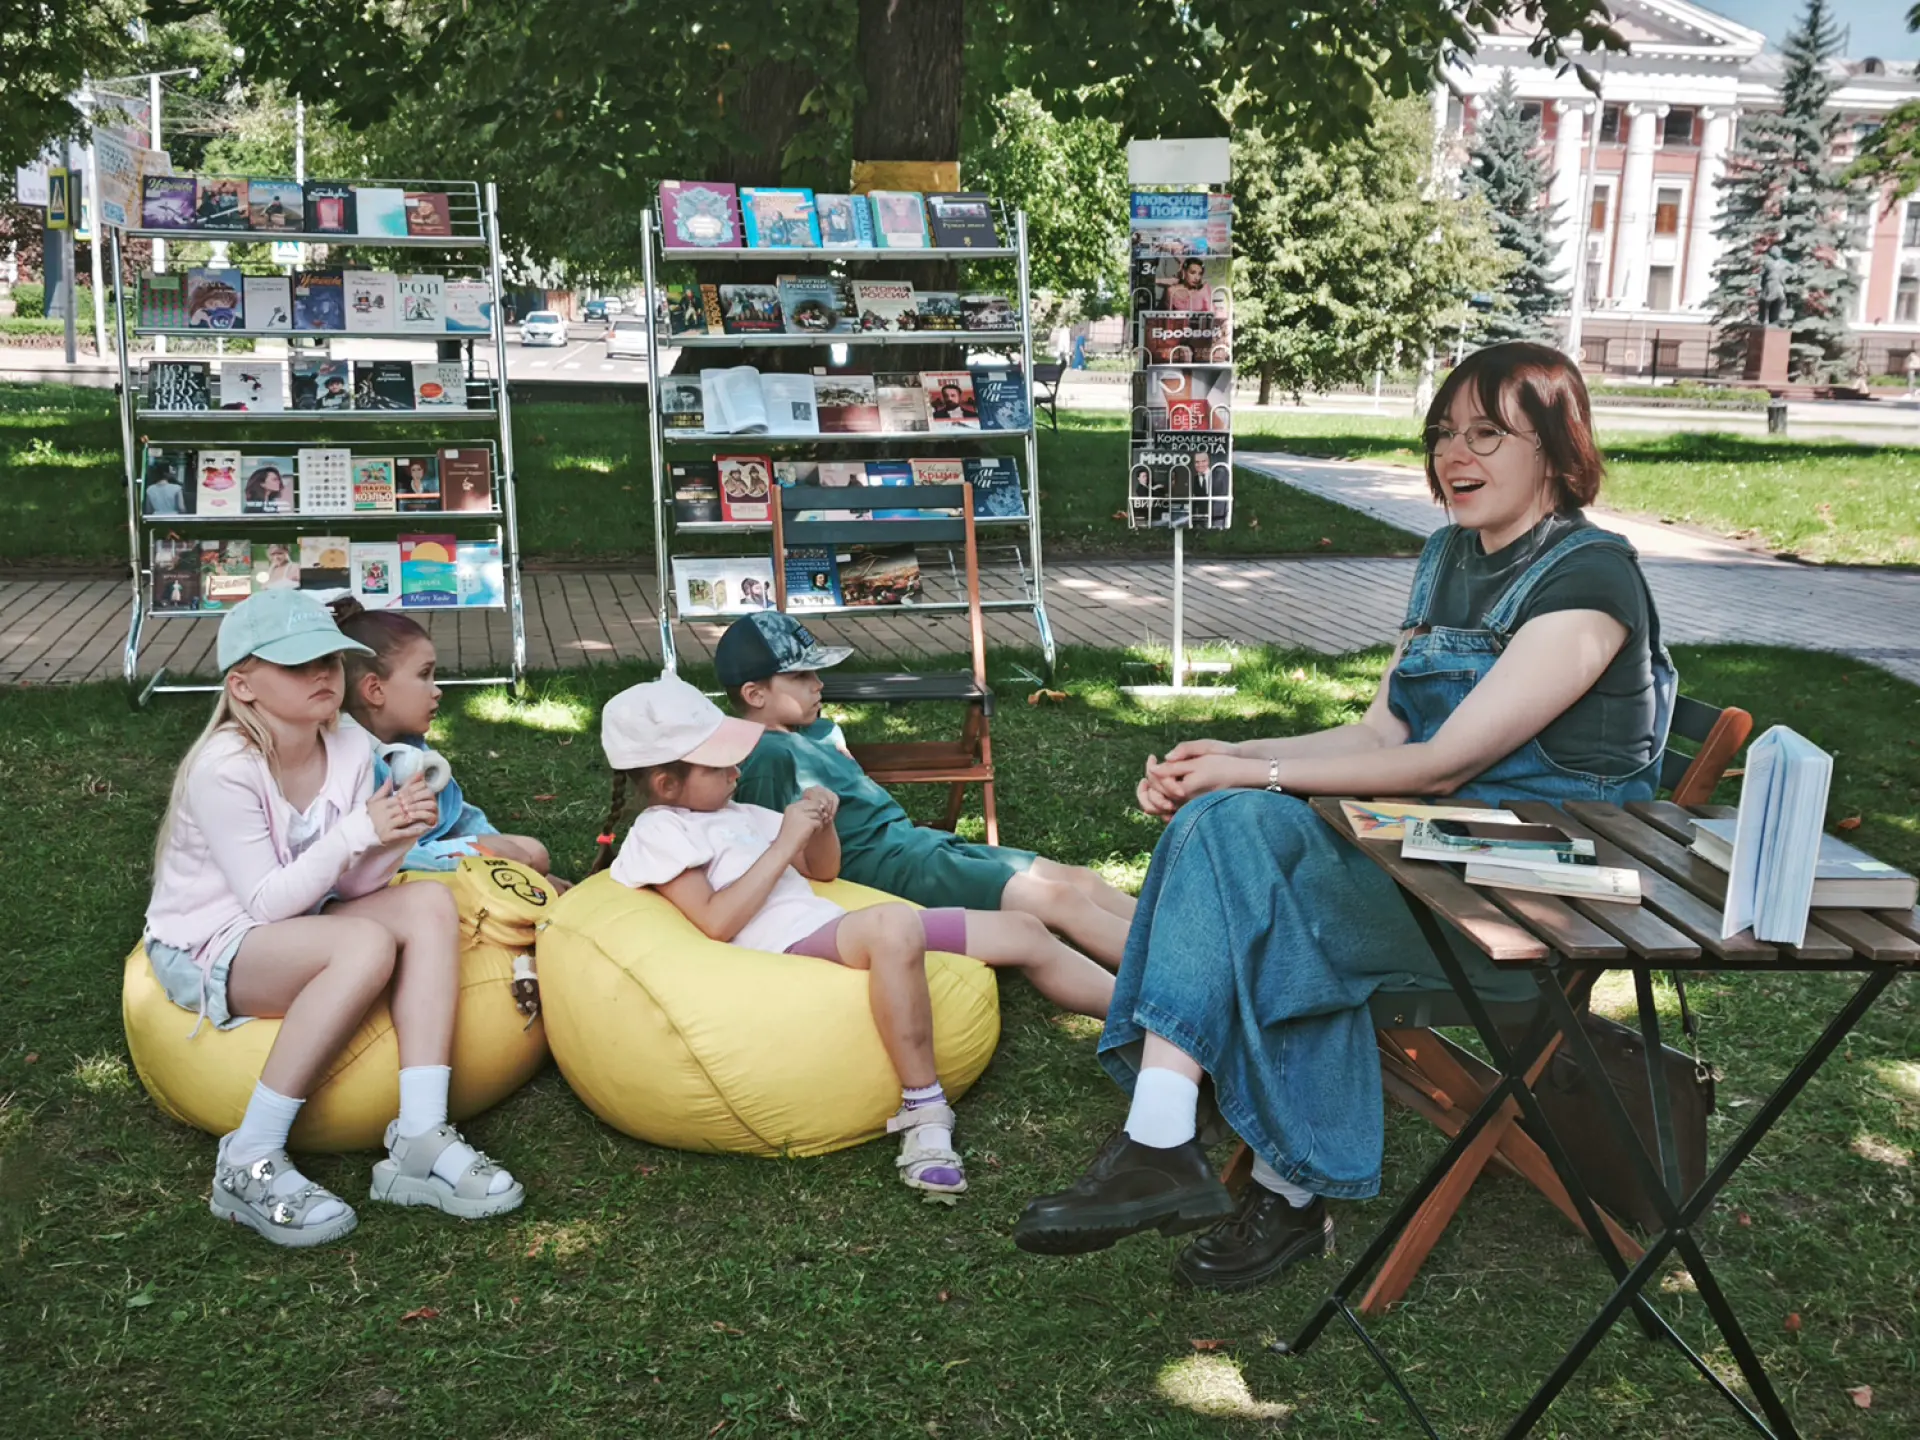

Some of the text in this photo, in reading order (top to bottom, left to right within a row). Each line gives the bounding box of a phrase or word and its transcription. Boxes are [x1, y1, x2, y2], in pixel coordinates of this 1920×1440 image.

[1135, 195, 1204, 206] МОРСКИЕ
[1151, 206, 1204, 216] ПОРТЫ
[399, 281, 440, 296] РОЙ
[1152, 327, 1222, 340] Бродвей
[1173, 414, 1204, 425] BEST
[355, 493, 393, 501] КОЭЛЬО
